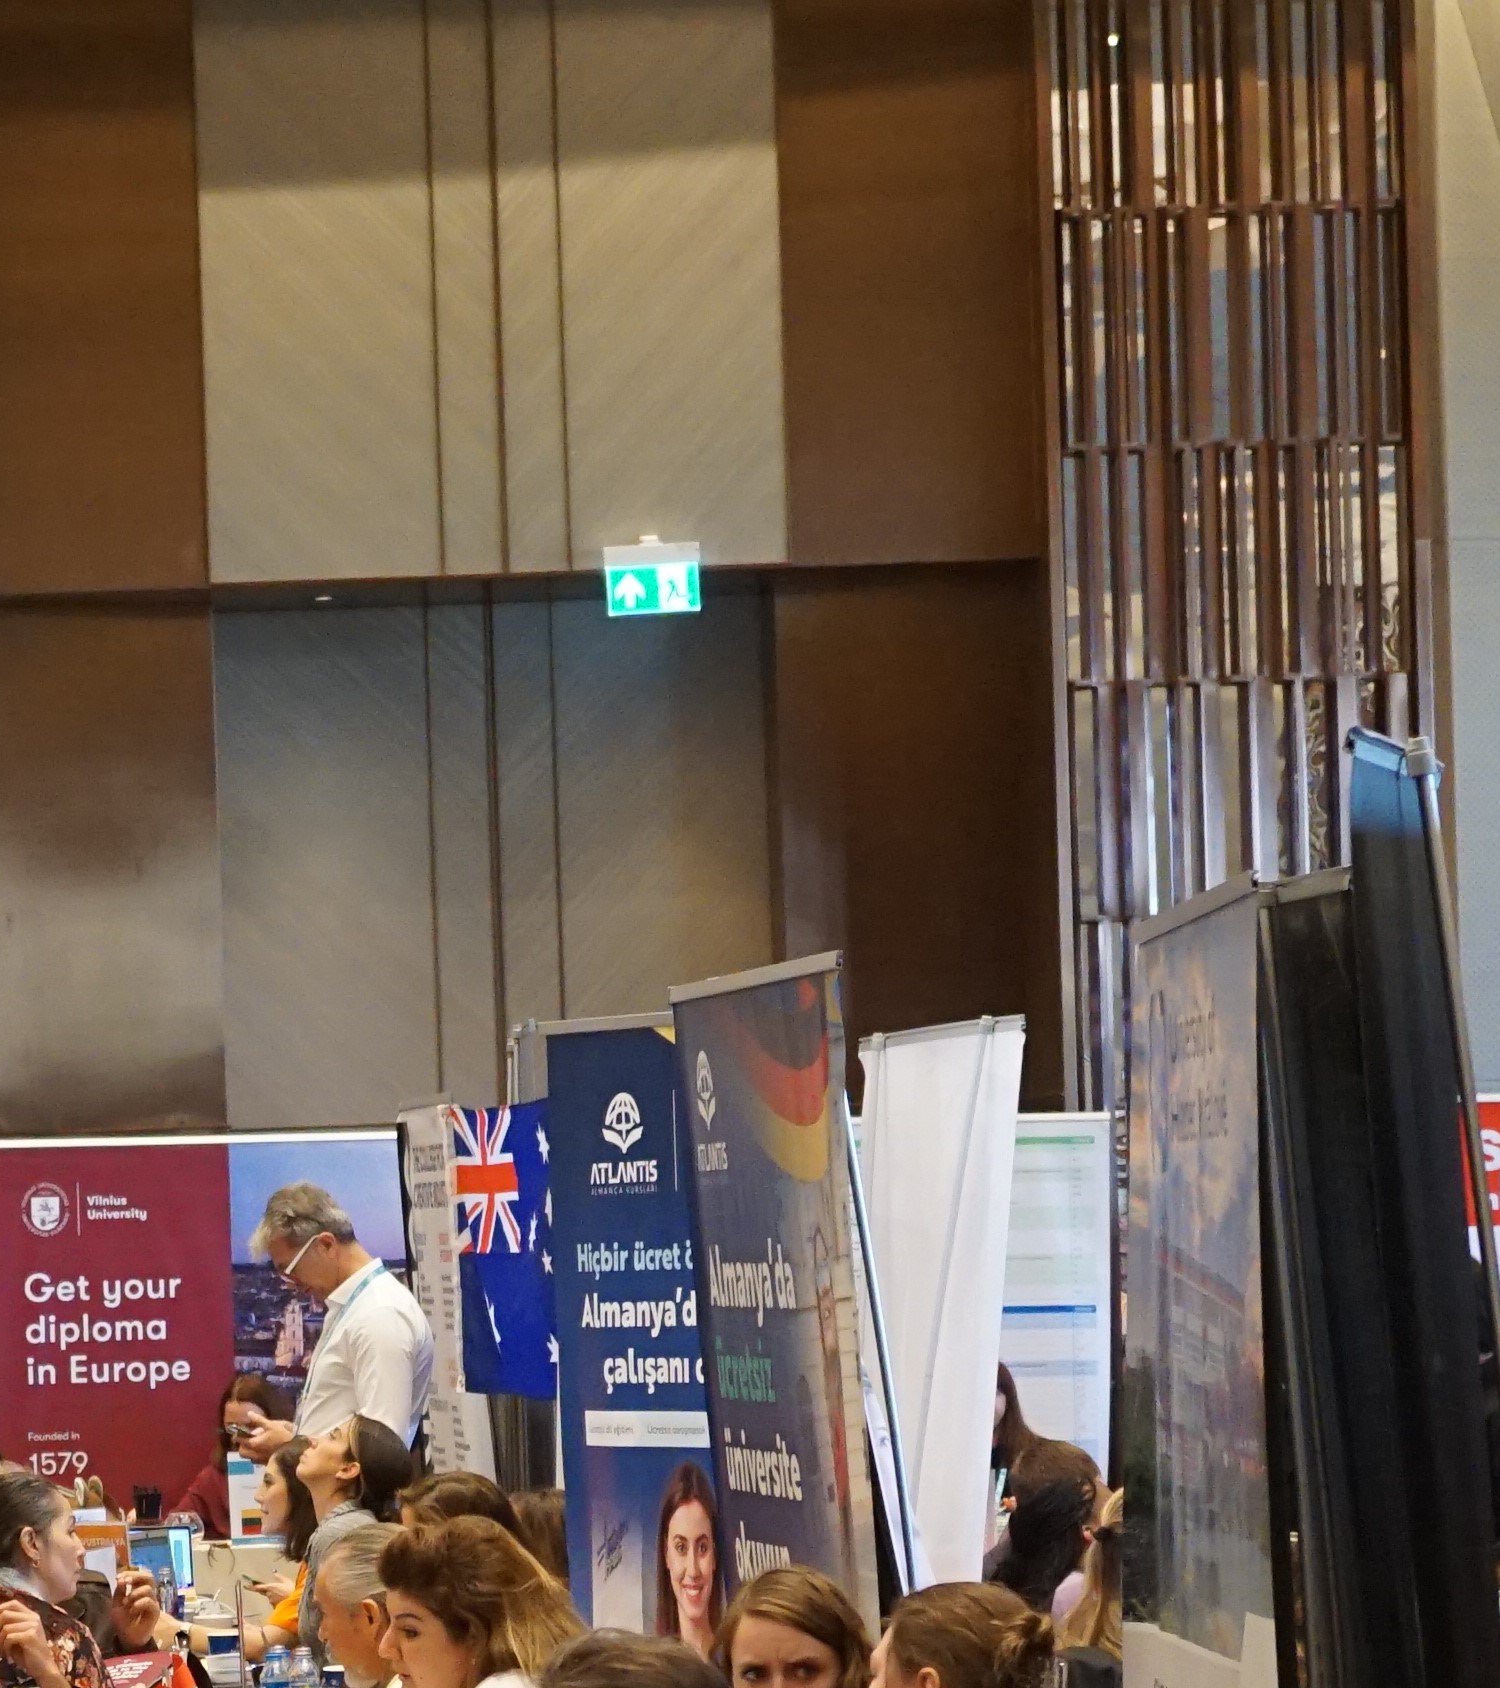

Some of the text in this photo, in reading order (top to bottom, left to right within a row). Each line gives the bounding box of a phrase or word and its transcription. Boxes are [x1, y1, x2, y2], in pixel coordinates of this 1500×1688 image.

[590, 1160, 659, 1185] ATLANTIS
[86, 1195, 127, 1206] Vilnius
[86, 1208, 147, 1221] University
[577, 1241, 628, 1281] Hiçbir
[633, 1241, 681, 1271] ücret
[24, 1272, 181, 1308] Get your
[709, 1238, 796, 1328] Almanya'da
[25, 1313, 167, 1350] diploma
[27, 1354, 191, 1389] in Europe
[604, 1348, 689, 1394] çalışanı
[28, 1432, 80, 1442] Founded in
[29, 1451, 89, 1475] 1579
[724, 1428, 803, 1501] üniversite
